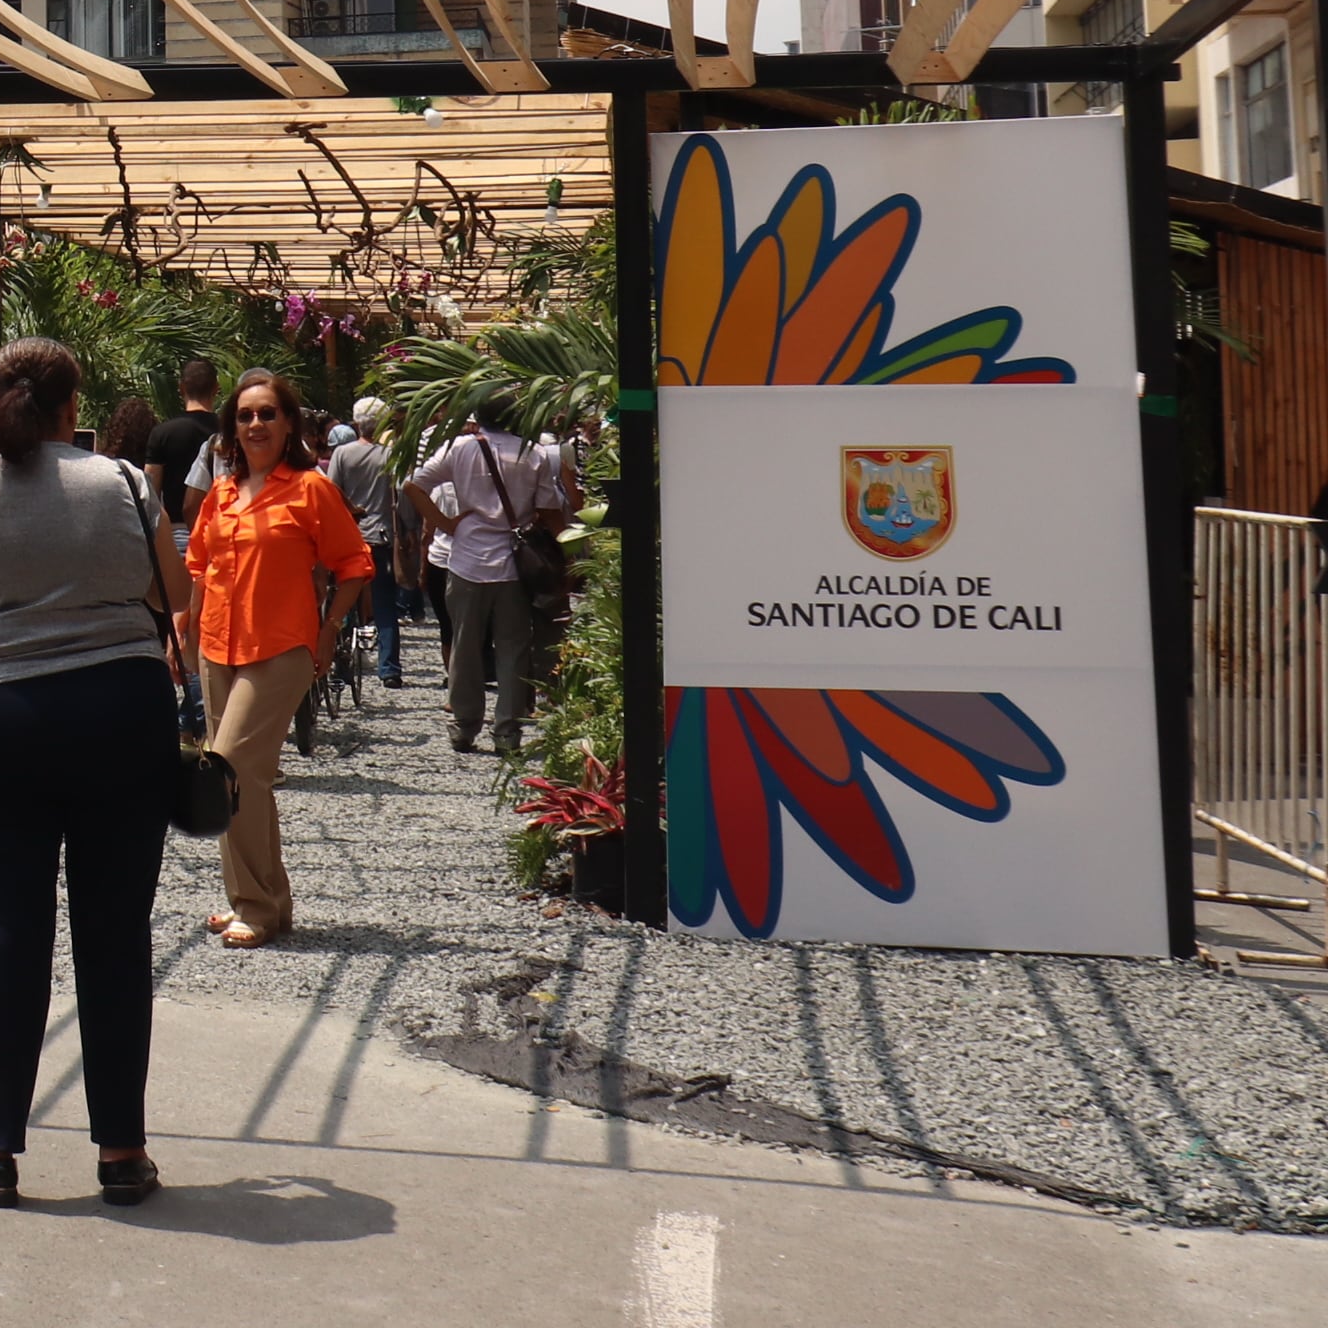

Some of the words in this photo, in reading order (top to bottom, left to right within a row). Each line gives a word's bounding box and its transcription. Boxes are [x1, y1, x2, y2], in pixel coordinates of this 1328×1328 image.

[815, 570, 947, 596] ALCALDÍA
[957, 576, 992, 596] DE
[747, 602, 921, 629] SANTIAGO
[932, 605, 977, 629] DE
[988, 605, 1063, 632] CALI
